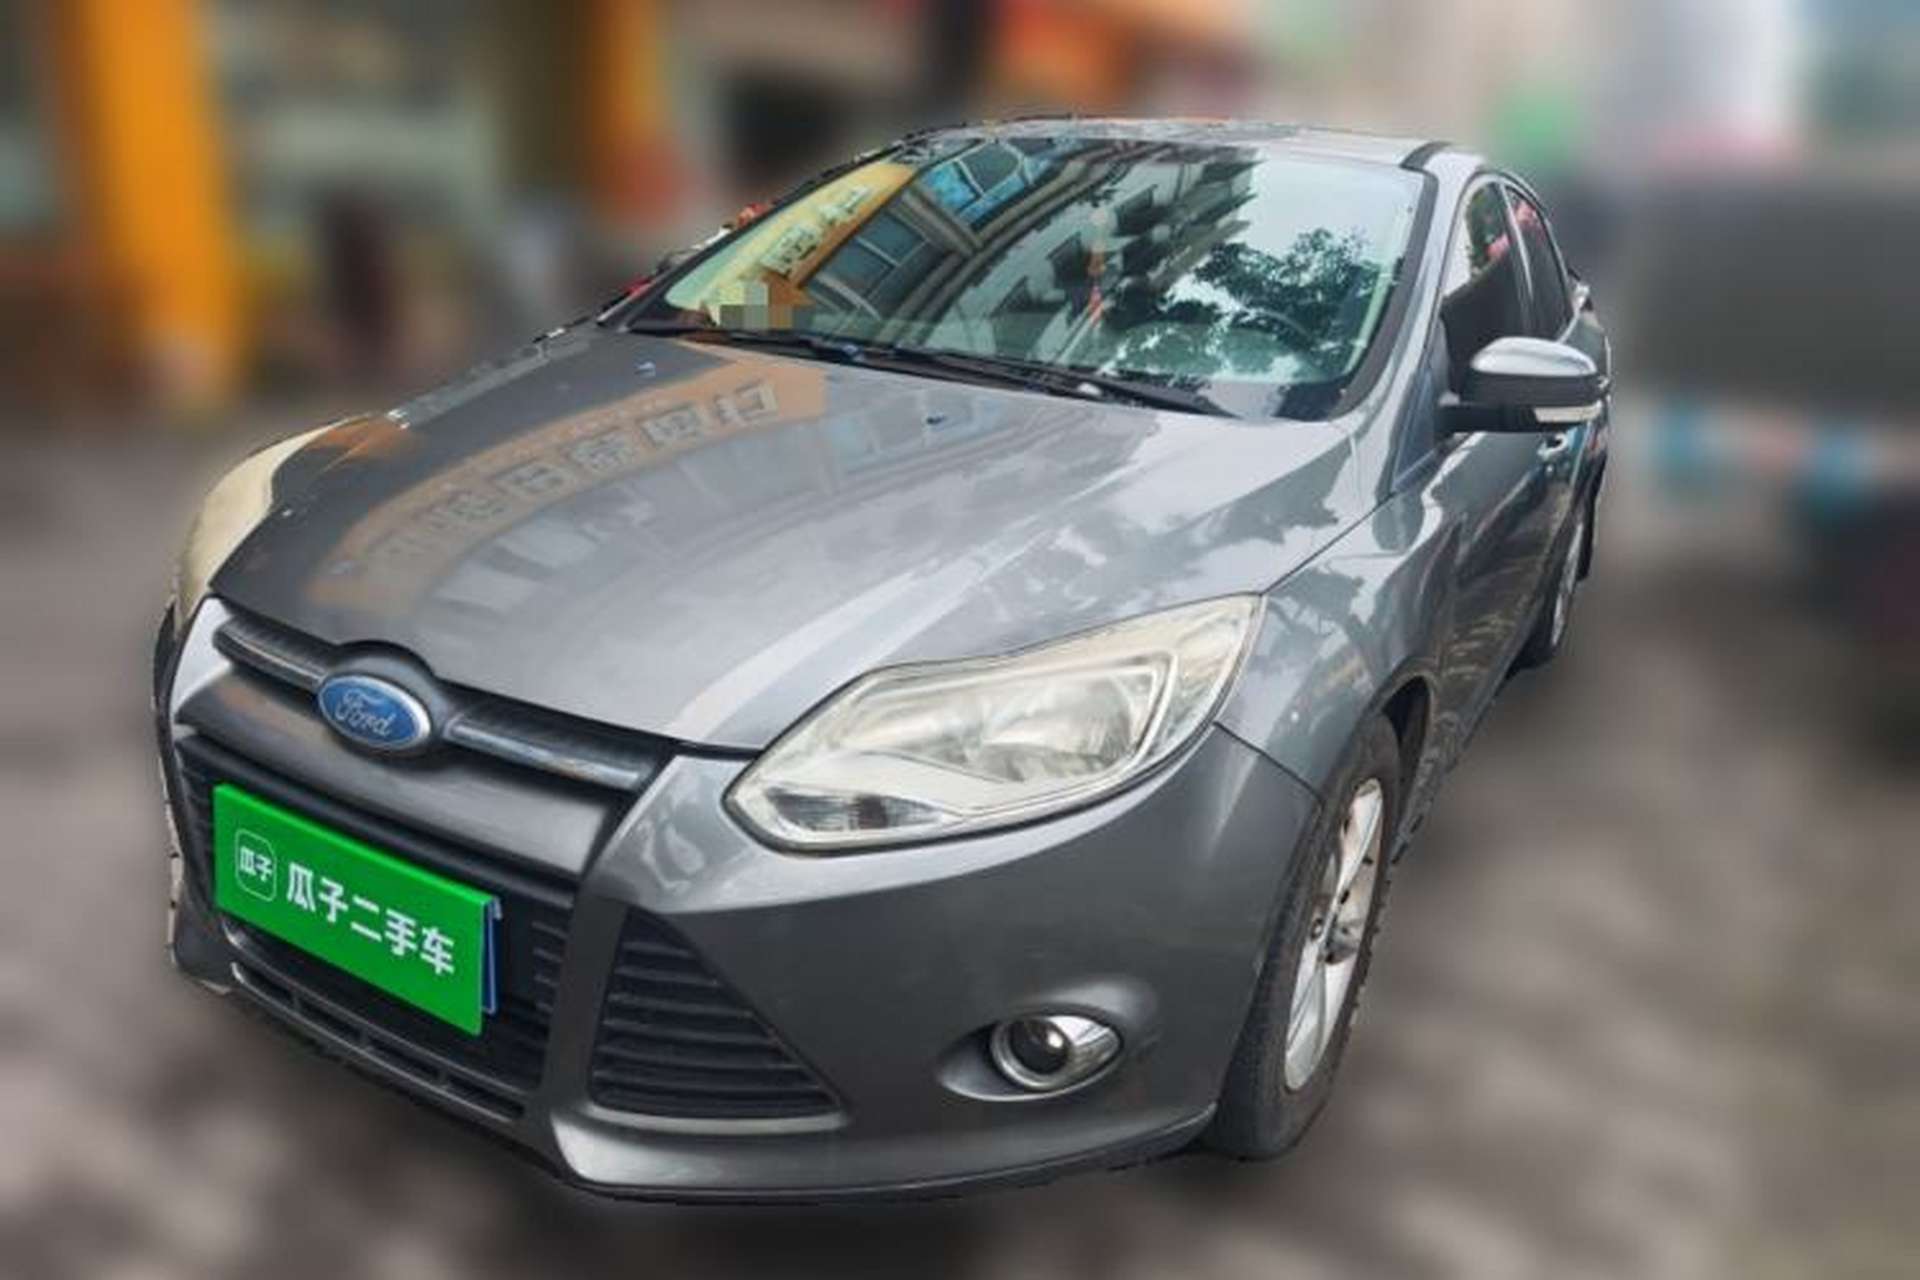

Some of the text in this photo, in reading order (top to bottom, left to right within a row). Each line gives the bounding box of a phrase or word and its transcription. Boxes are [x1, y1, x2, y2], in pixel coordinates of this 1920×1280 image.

[335, 688, 397, 737] Ford
[239, 846, 273, 882] 瓜子
[286, 861, 455, 975] 瓜子二手车
